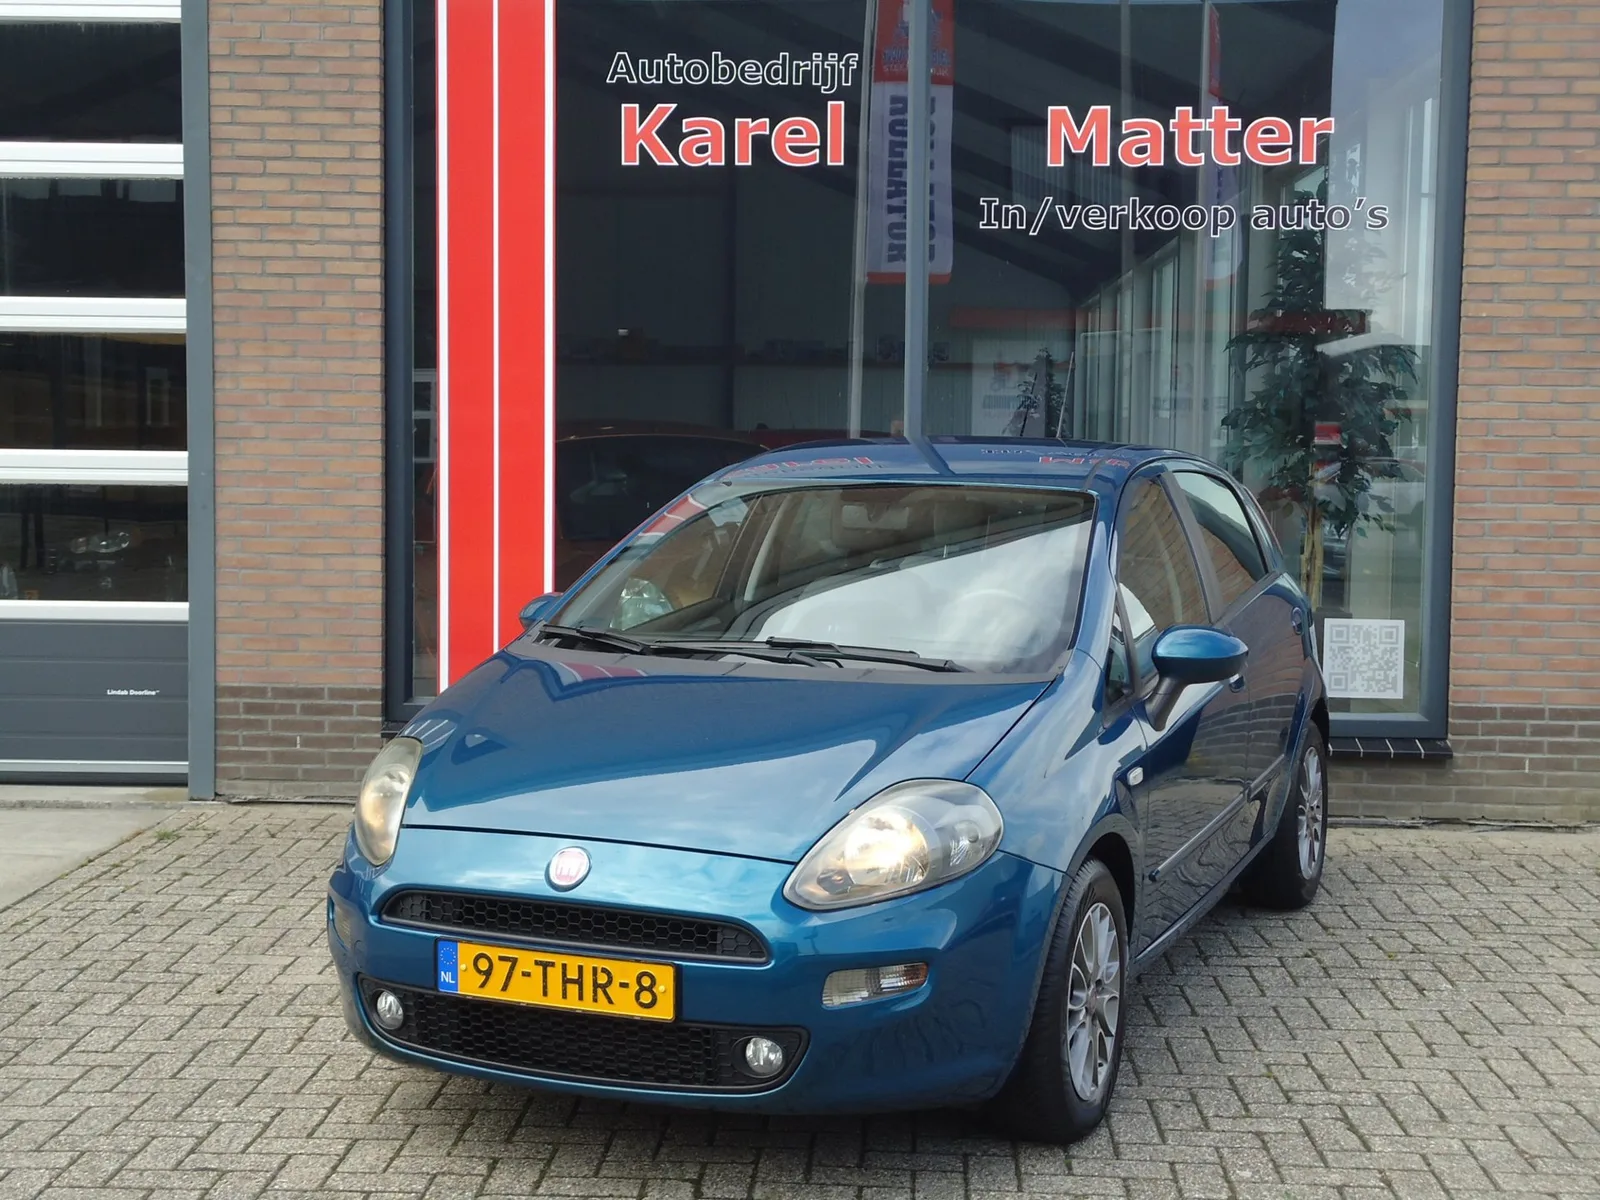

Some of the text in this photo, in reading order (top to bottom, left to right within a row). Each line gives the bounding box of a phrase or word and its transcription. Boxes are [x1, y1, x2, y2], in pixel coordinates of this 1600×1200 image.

[606, 51, 859, 93] Autobedrijf
[620, 101, 1335, 168] Karel Matter
[978, 197, 1390, 238] In/verkoop auto's
[440, 971, 456, 985] NL
[472, 952, 659, 1009] 97-THR-8
